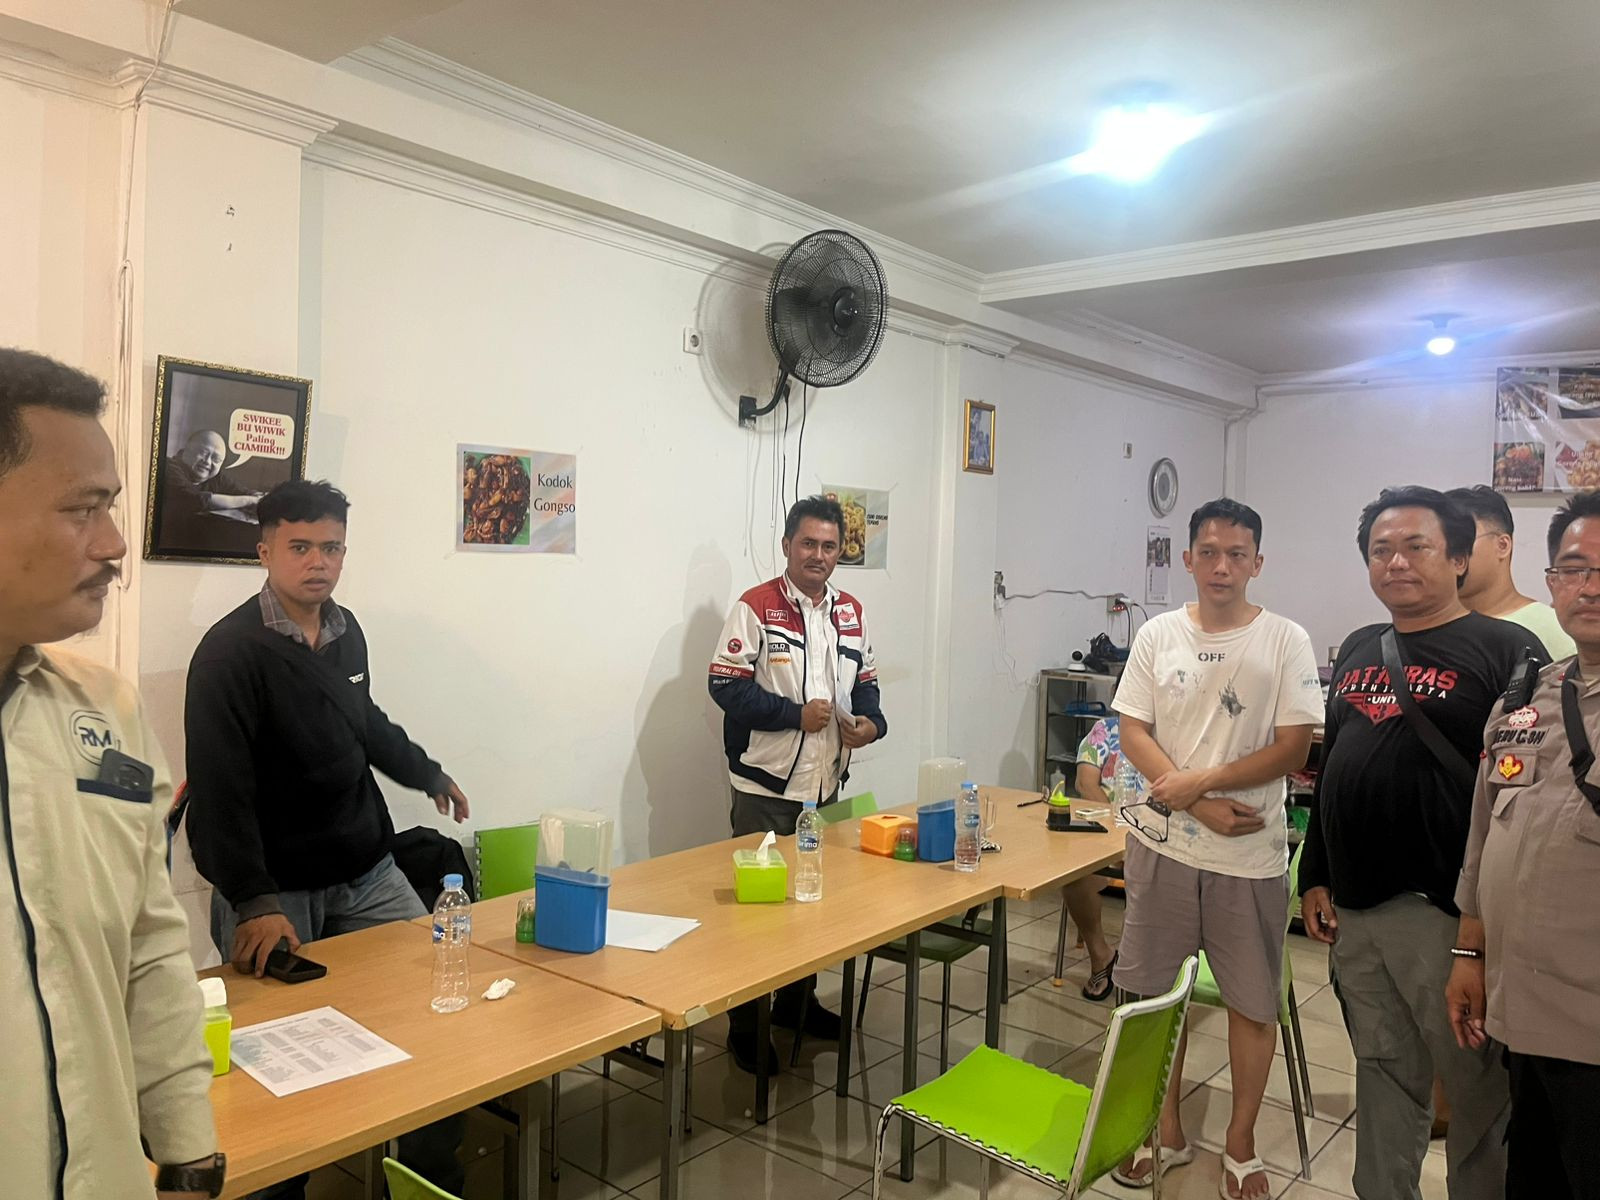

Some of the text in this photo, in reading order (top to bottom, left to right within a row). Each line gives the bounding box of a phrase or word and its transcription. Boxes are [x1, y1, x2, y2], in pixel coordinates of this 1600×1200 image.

[243, 413, 281, 426] SWIKEE
[237, 422, 286, 437] BU WIWIK
[246, 433, 276, 446] Paling
[538, 473, 573, 489] Kodok
[533, 497, 576, 516] Gongso
[1198, 652, 1225, 662] OFF
[1336, 665, 1458, 690] JATARAS
[1383, 684, 1446, 699] JRTA
